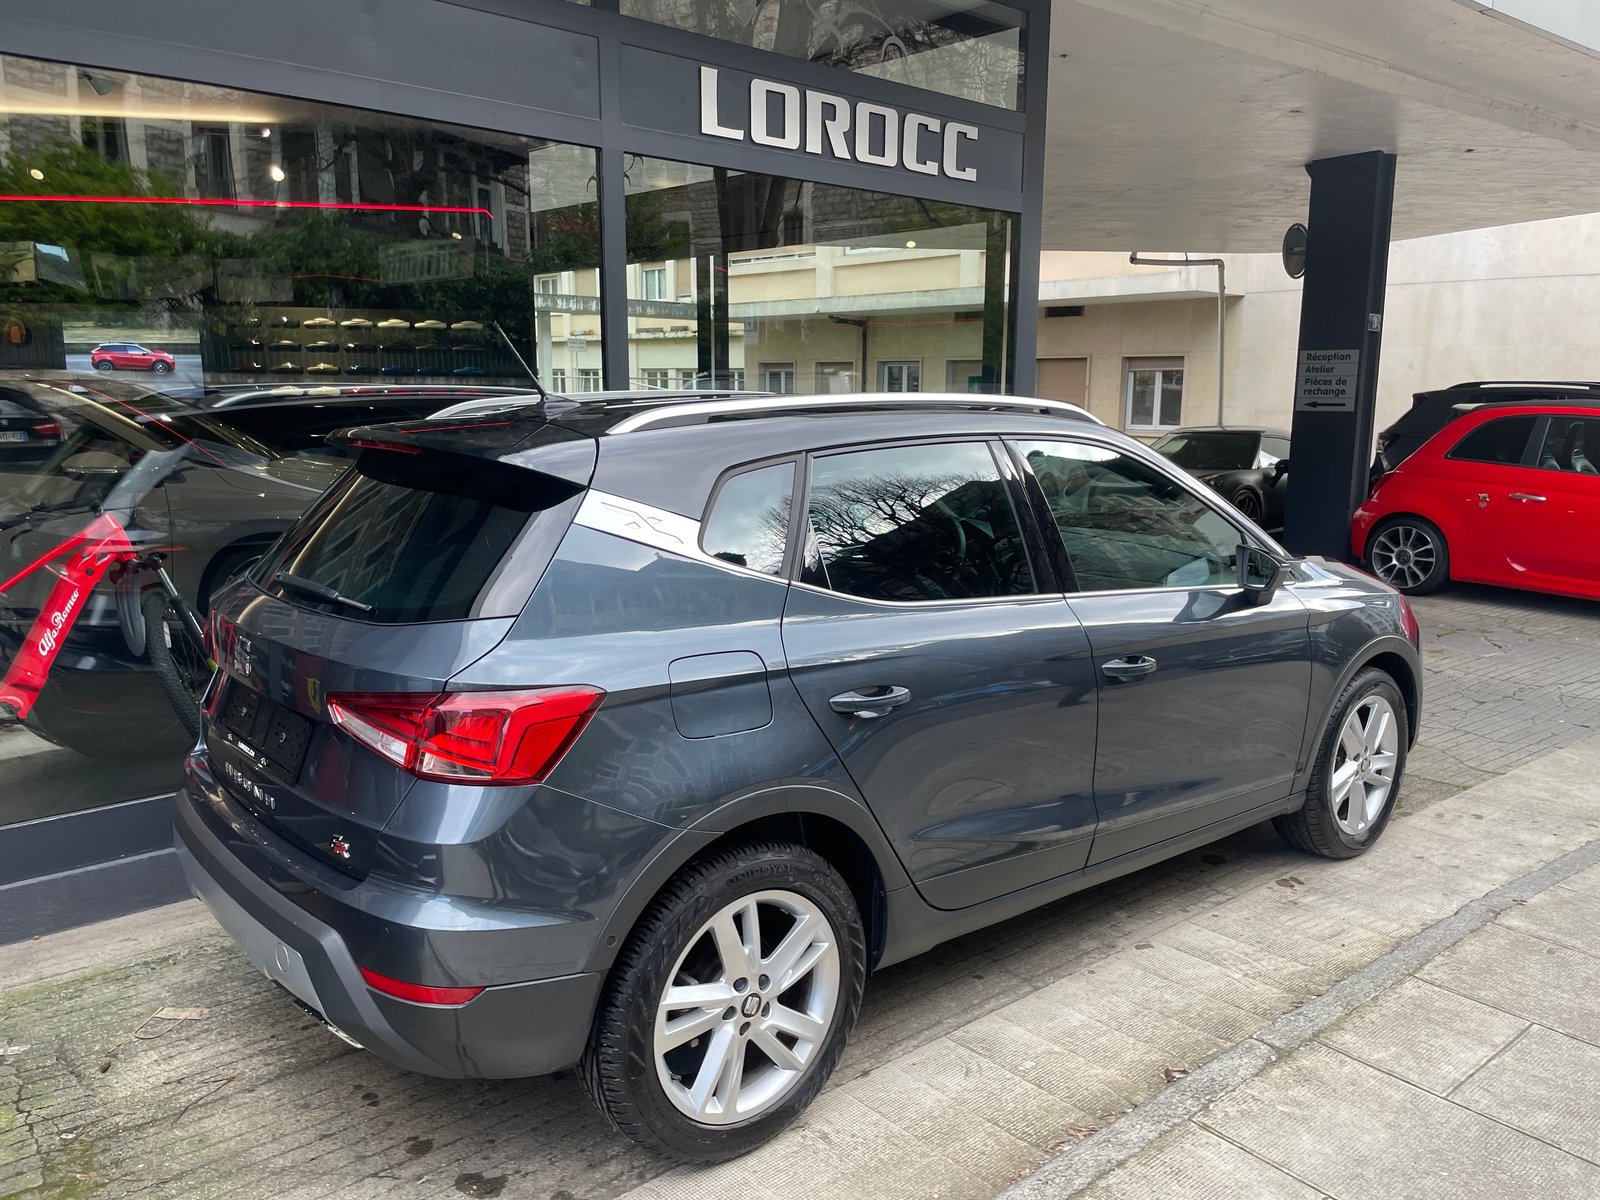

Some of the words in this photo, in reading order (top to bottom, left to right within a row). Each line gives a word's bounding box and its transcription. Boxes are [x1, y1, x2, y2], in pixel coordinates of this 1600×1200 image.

[700, 66, 979, 182] LOROCC
[1306, 352, 1351, 363] Réception
[1305, 365, 1335, 374] Atelier
[1304, 377, 1332, 386] Pièces
[1335, 377, 1347, 386] de
[1303, 387, 1346, 398] rechange
[38, 628, 59, 656] Alfa
[51, 588, 79, 629] Romeo
